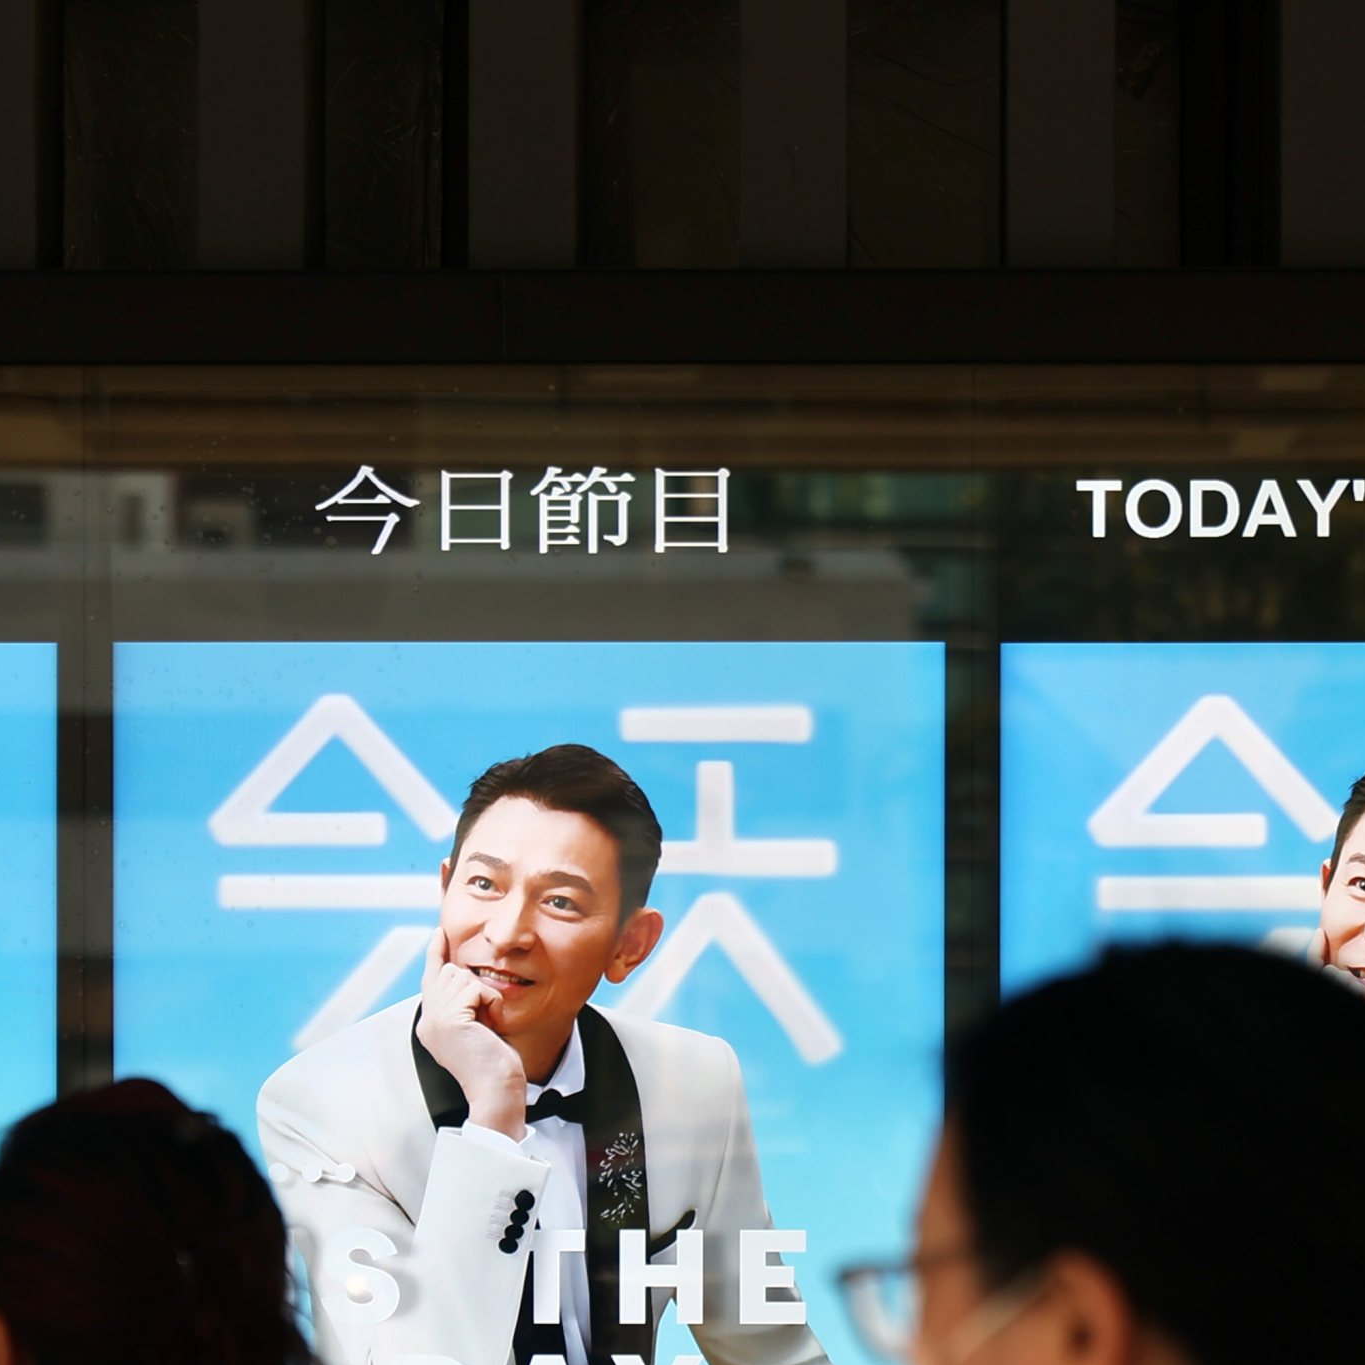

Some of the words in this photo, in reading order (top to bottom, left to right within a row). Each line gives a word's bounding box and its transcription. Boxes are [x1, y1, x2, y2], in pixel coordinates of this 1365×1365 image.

[314, 464, 730, 556] 今日節目
[289, 1226, 401, 1324] S
[511, 1228, 807, 1325] THE
